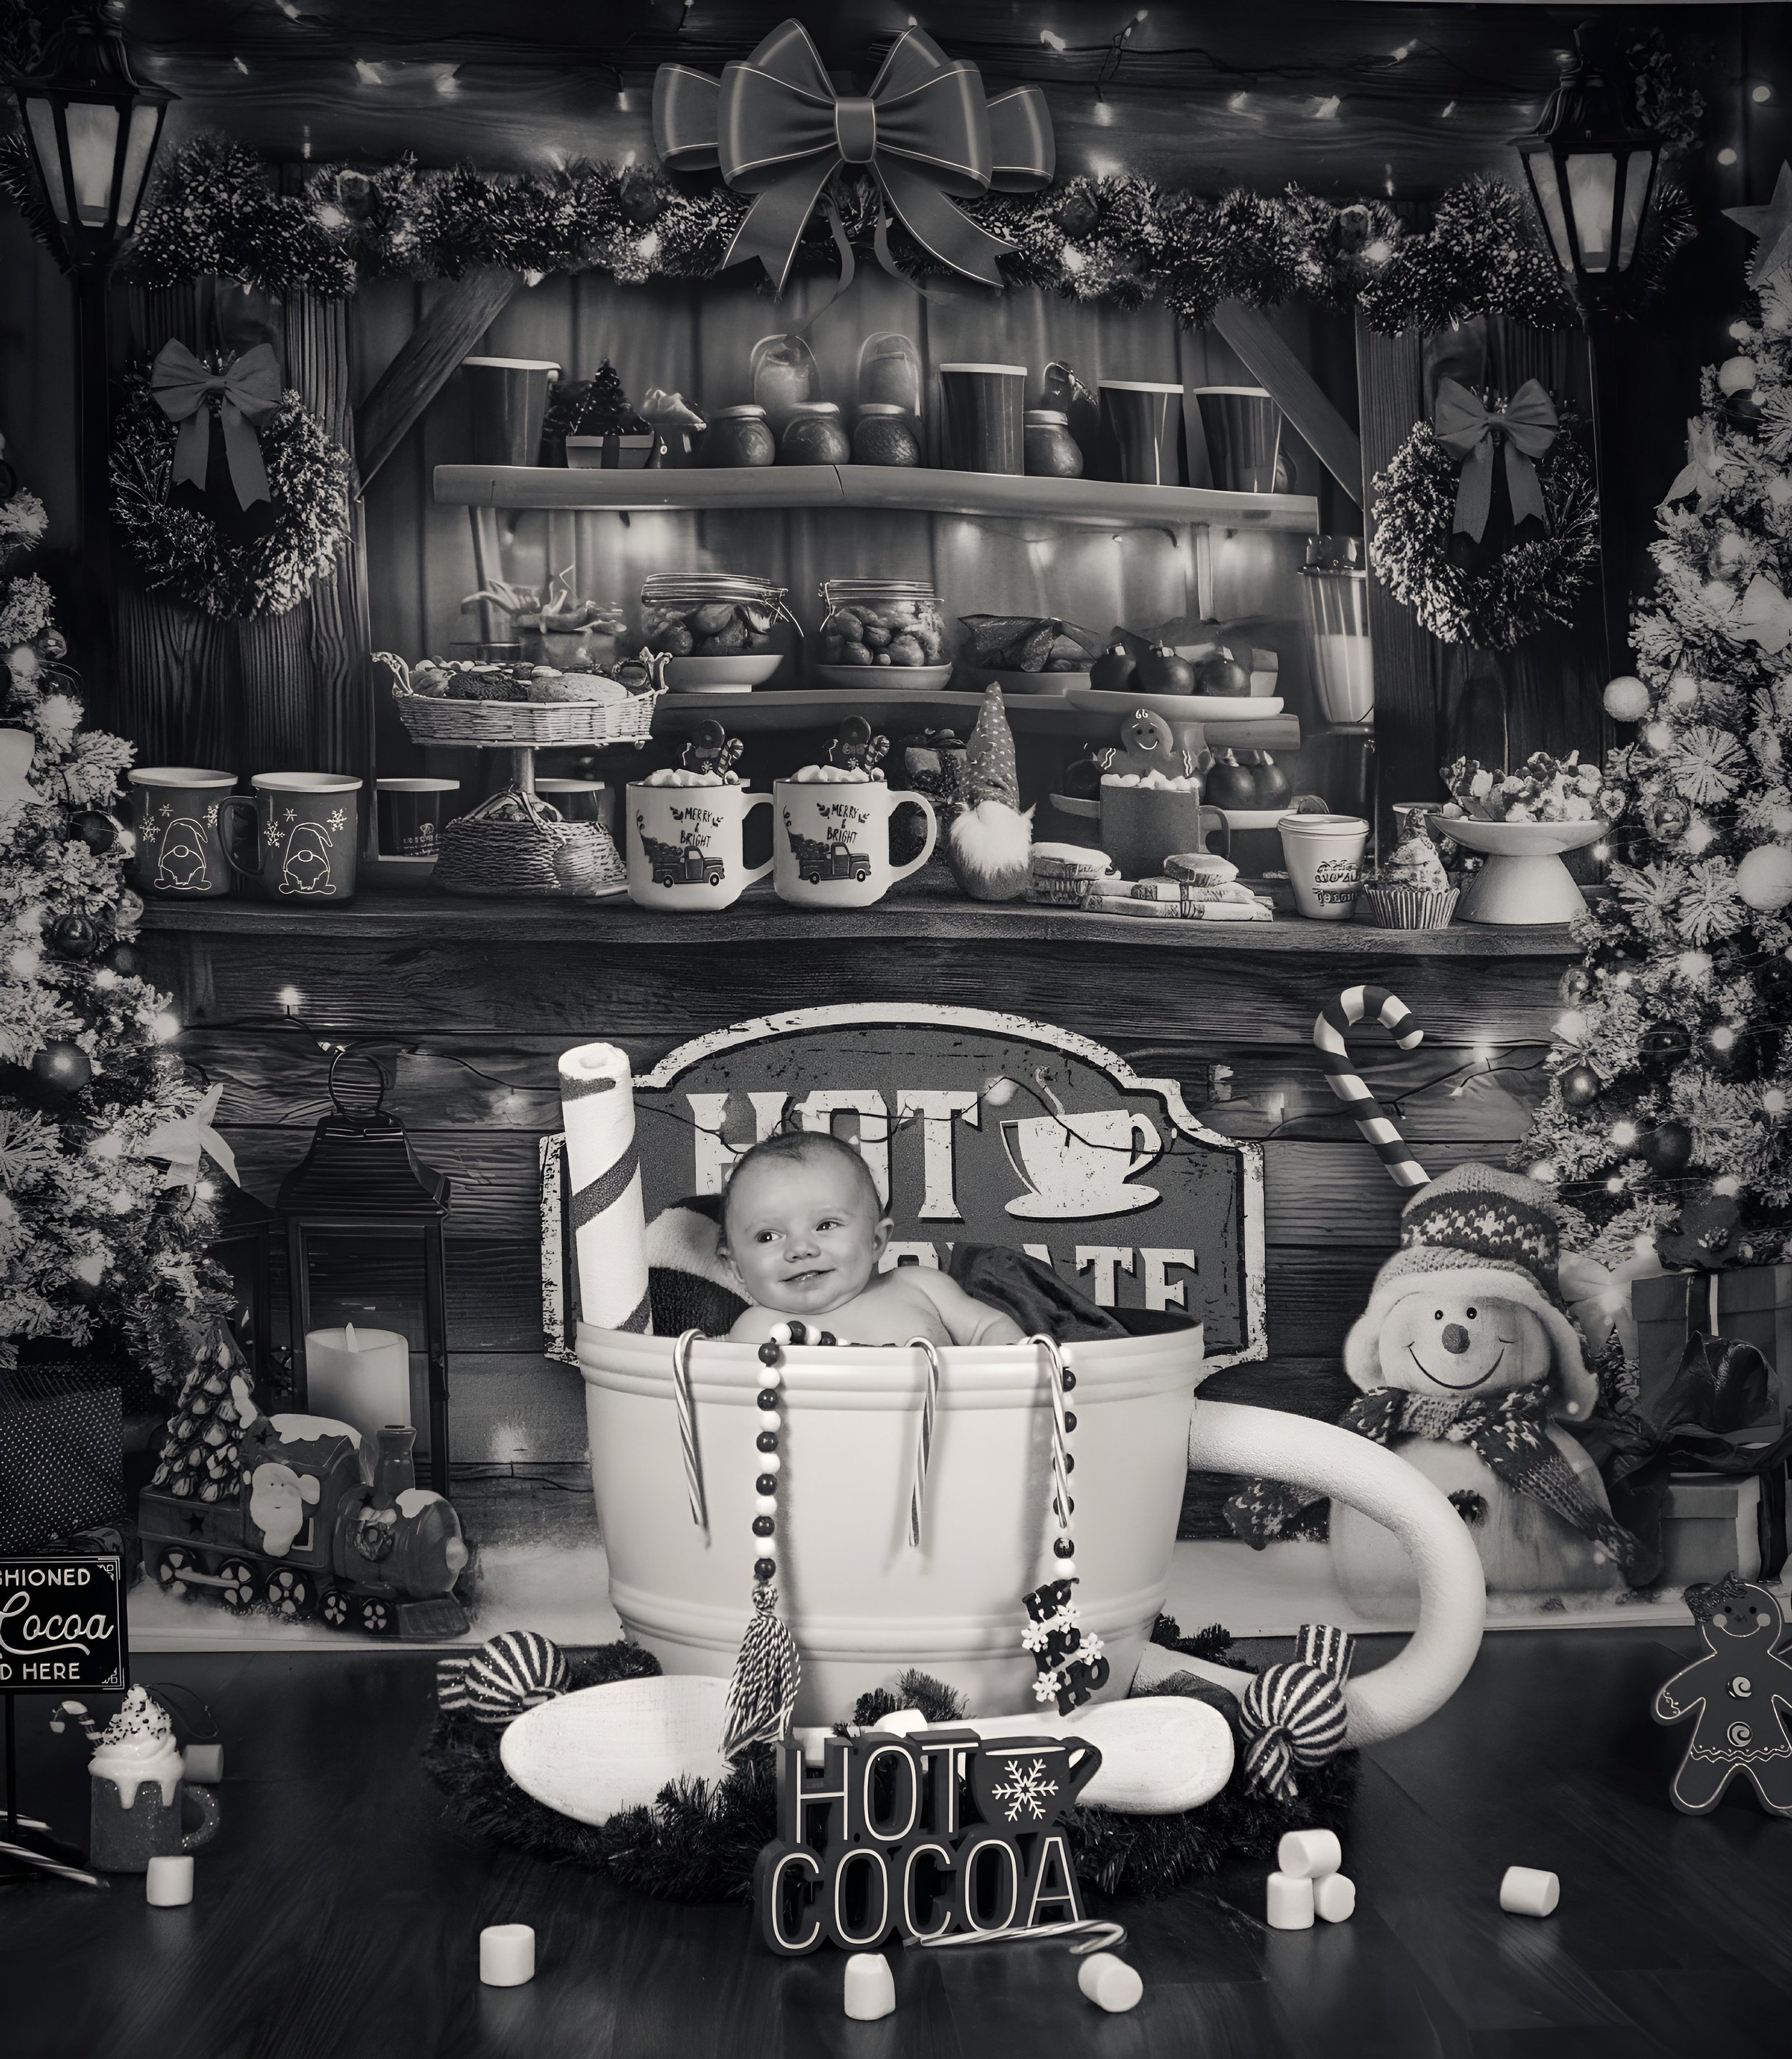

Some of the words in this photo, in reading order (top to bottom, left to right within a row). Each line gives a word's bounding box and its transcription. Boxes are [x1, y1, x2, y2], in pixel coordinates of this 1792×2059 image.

[685, 807, 712, 823] MERRY
[831, 803, 859, 819] MERRY
[680, 830, 712, 848] BRIGHT
[826, 826, 858, 844] BRIGHT
[0, 1568, 91, 1587] HIONED
[0, 1591, 114, 1656] Cocoa
[23, 1662, 80, 1680] HERE
[795, 1742, 980, 1845] HOT
[771, 1836, 1080, 1950] COCOA
